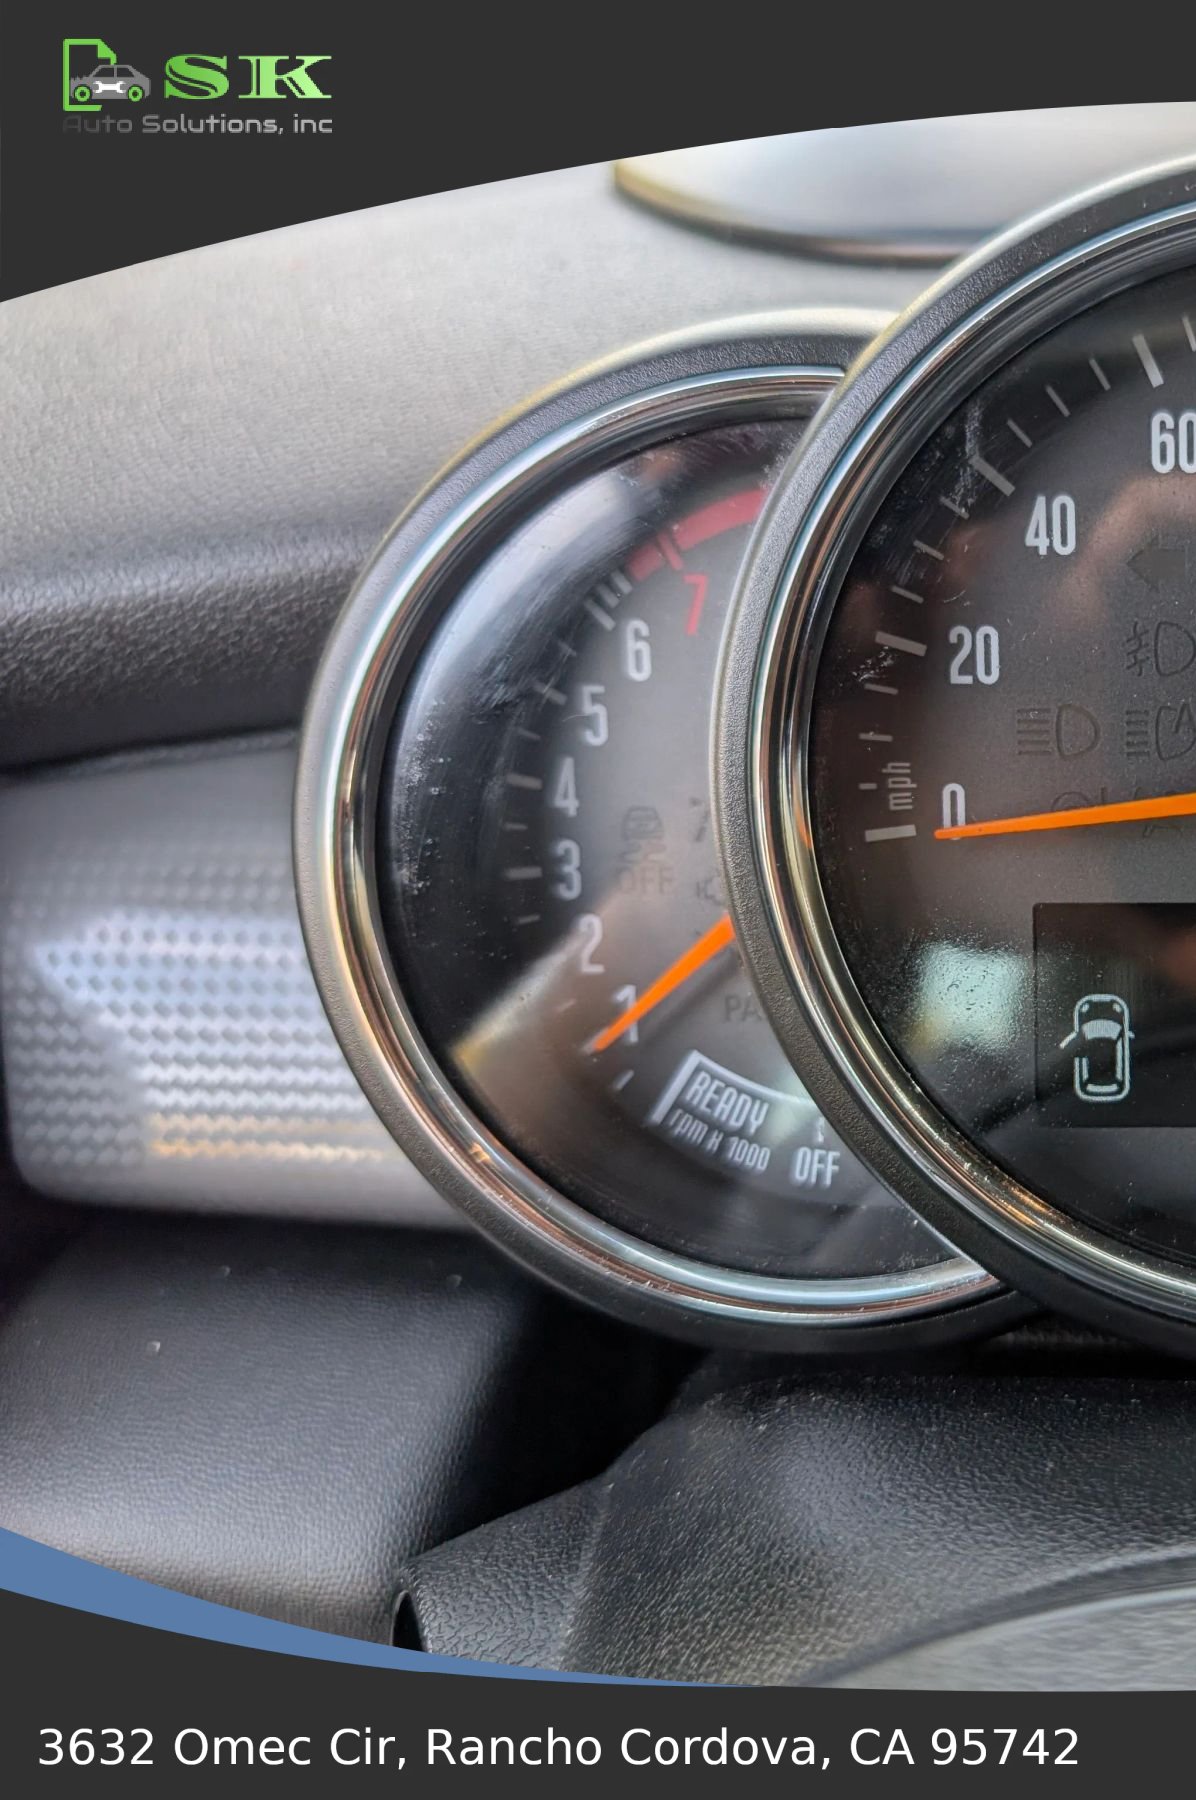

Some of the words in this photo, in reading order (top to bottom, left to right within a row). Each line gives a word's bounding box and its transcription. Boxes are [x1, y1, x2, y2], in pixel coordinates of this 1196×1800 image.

[1025, 494, 1077, 556] 40
[683, 574, 708, 637] 7
[626, 619, 651, 682] 6
[948, 625, 1000, 685] 20
[580, 685, 609, 746] 5
[554, 757, 580, 817] 4
[881, 762, 918, 811] mph
[942, 782, 967, 841] 0
[554, 839, 582, 900] 3
[578, 914, 605, 974] 2
[613, 983, 640, 1044] 1
[685, 1071, 769, 1135] READY
[669, 1107, 708, 1144] rpm
[727, 1136, 771, 1172] 1000
[794, 1146, 841, 1187] OFF
